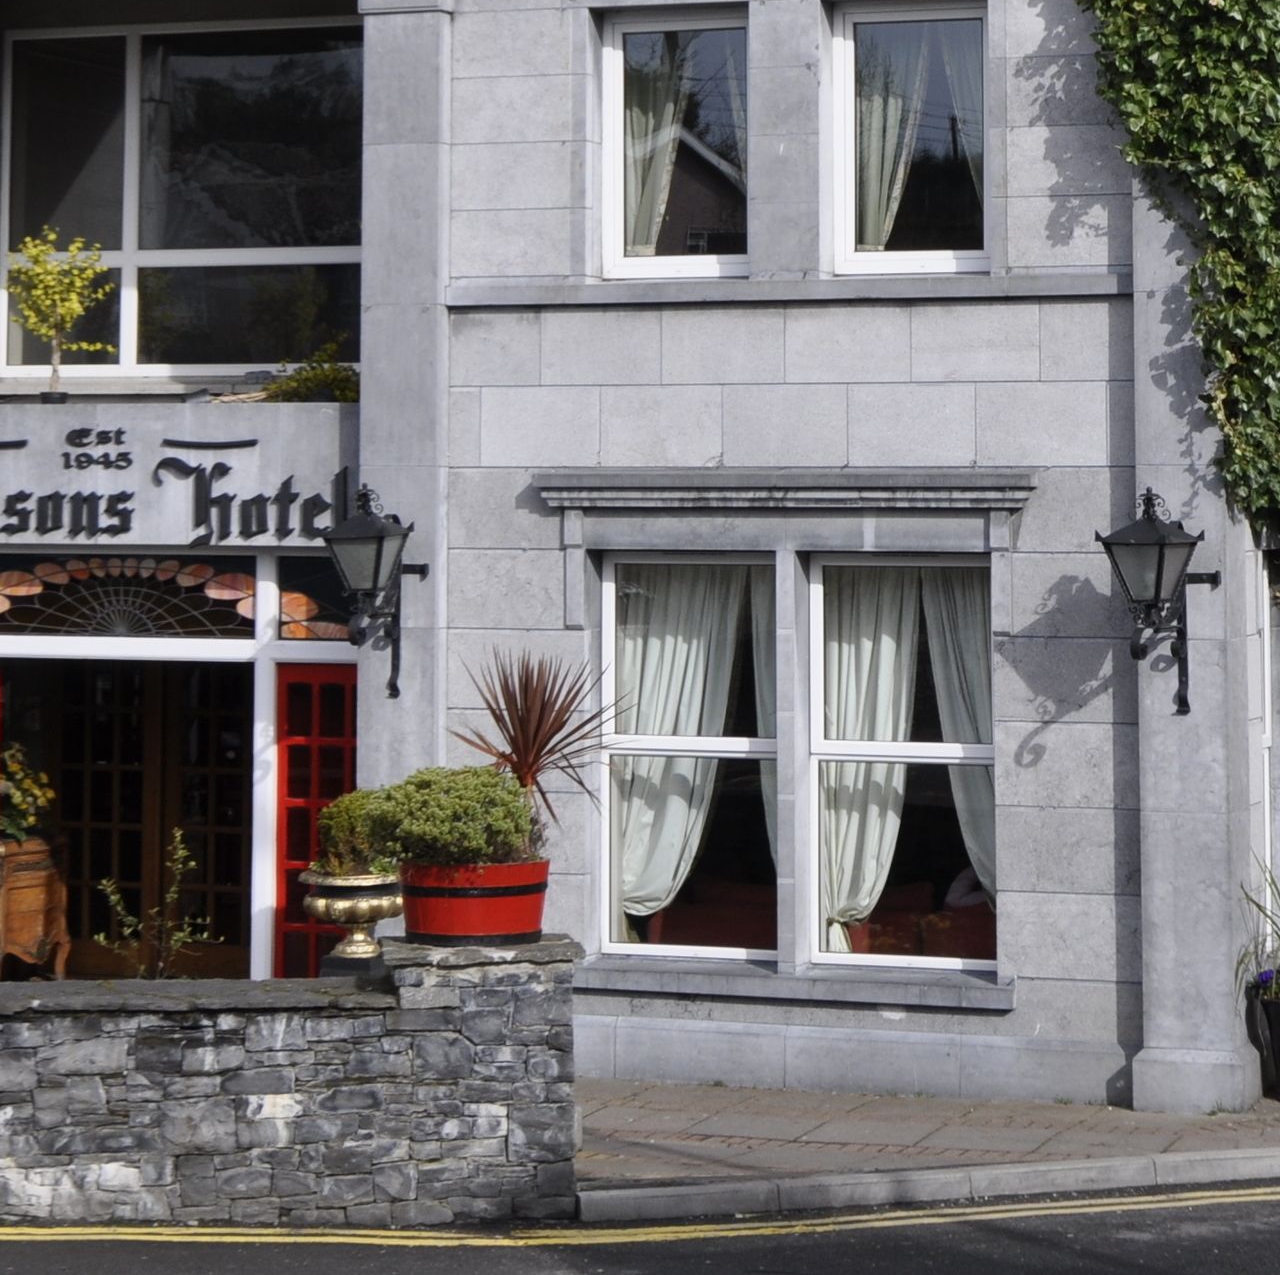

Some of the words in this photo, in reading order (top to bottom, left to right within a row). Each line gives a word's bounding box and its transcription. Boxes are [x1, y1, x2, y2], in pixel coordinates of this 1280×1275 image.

[64, 427, 127, 448] Est
[61, 451, 134, 471] 1945
[151, 456, 349, 549] Hotel
